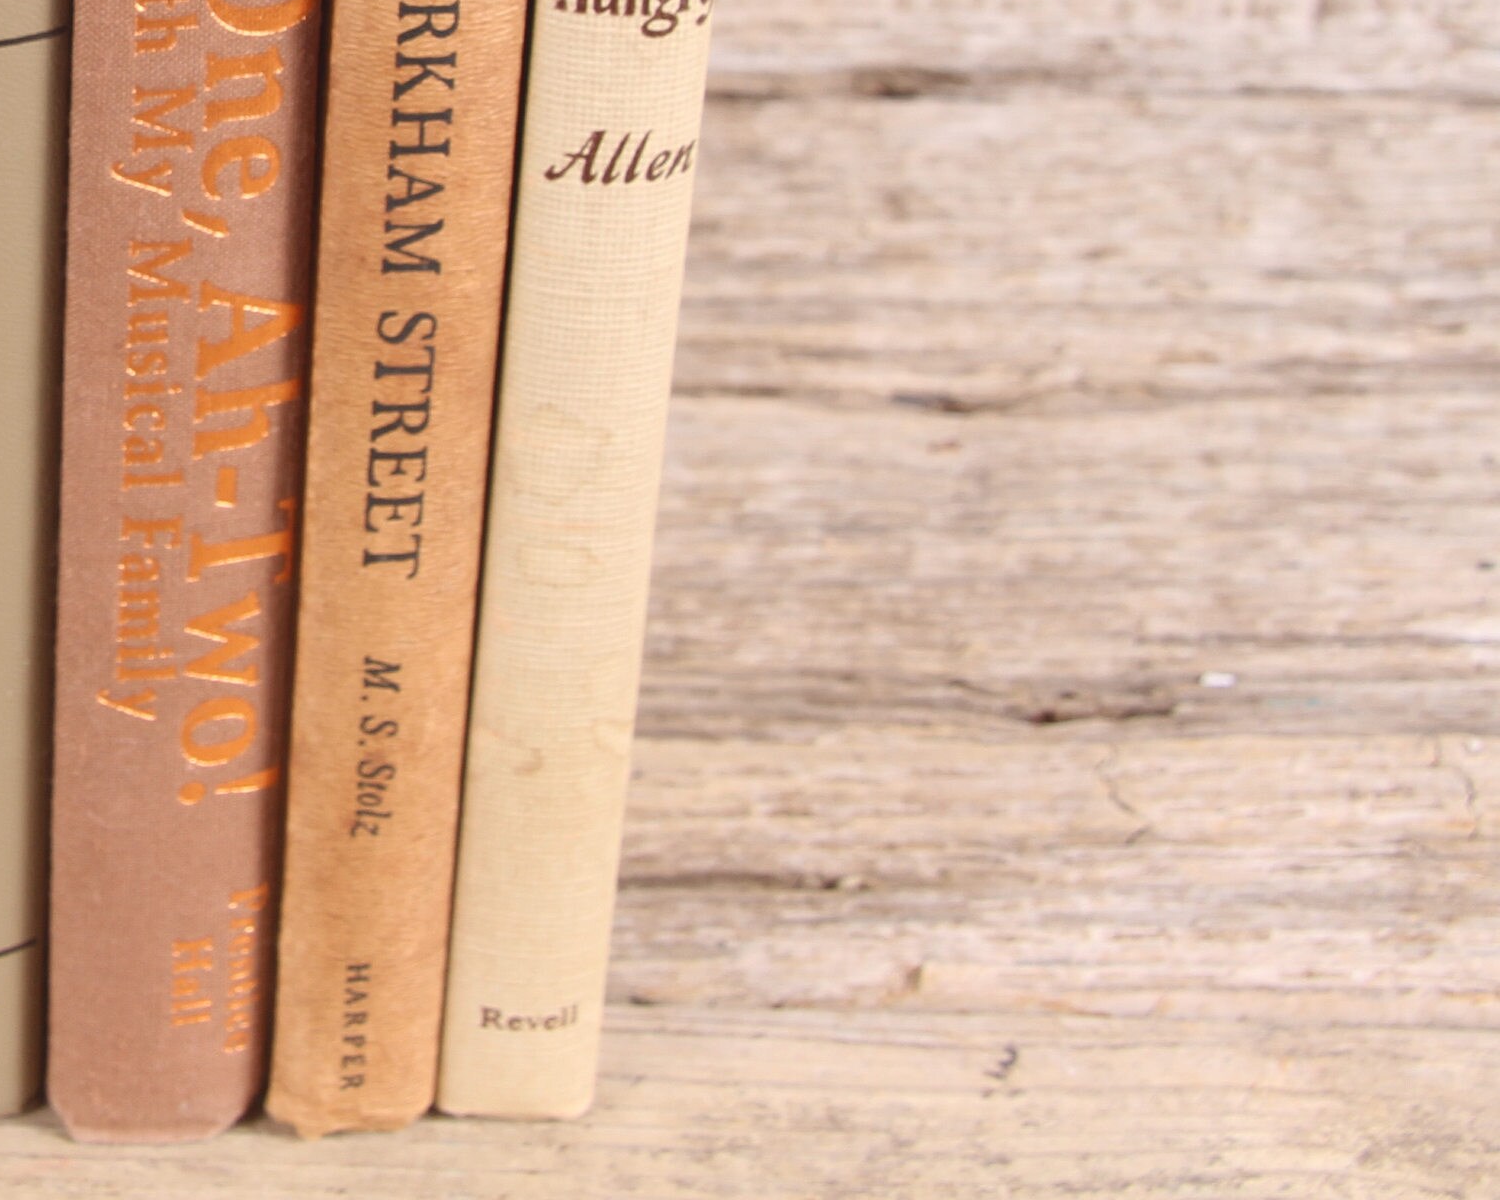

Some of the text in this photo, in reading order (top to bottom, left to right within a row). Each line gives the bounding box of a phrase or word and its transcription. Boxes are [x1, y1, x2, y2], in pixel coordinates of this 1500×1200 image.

[110, 84, 200, 197] My
[544, 129, 697, 185] Allen
[119, 238, 193, 492] Musical
[361, 309, 438, 581] STREET
[96, 513, 185, 722] Family
[350, 655, 402, 839] M. S. Stolz
[171, 937, 214, 1027] Hall
[339, 962, 373, 1091] HARPER
[480, 1003, 579, 1032] Revell
